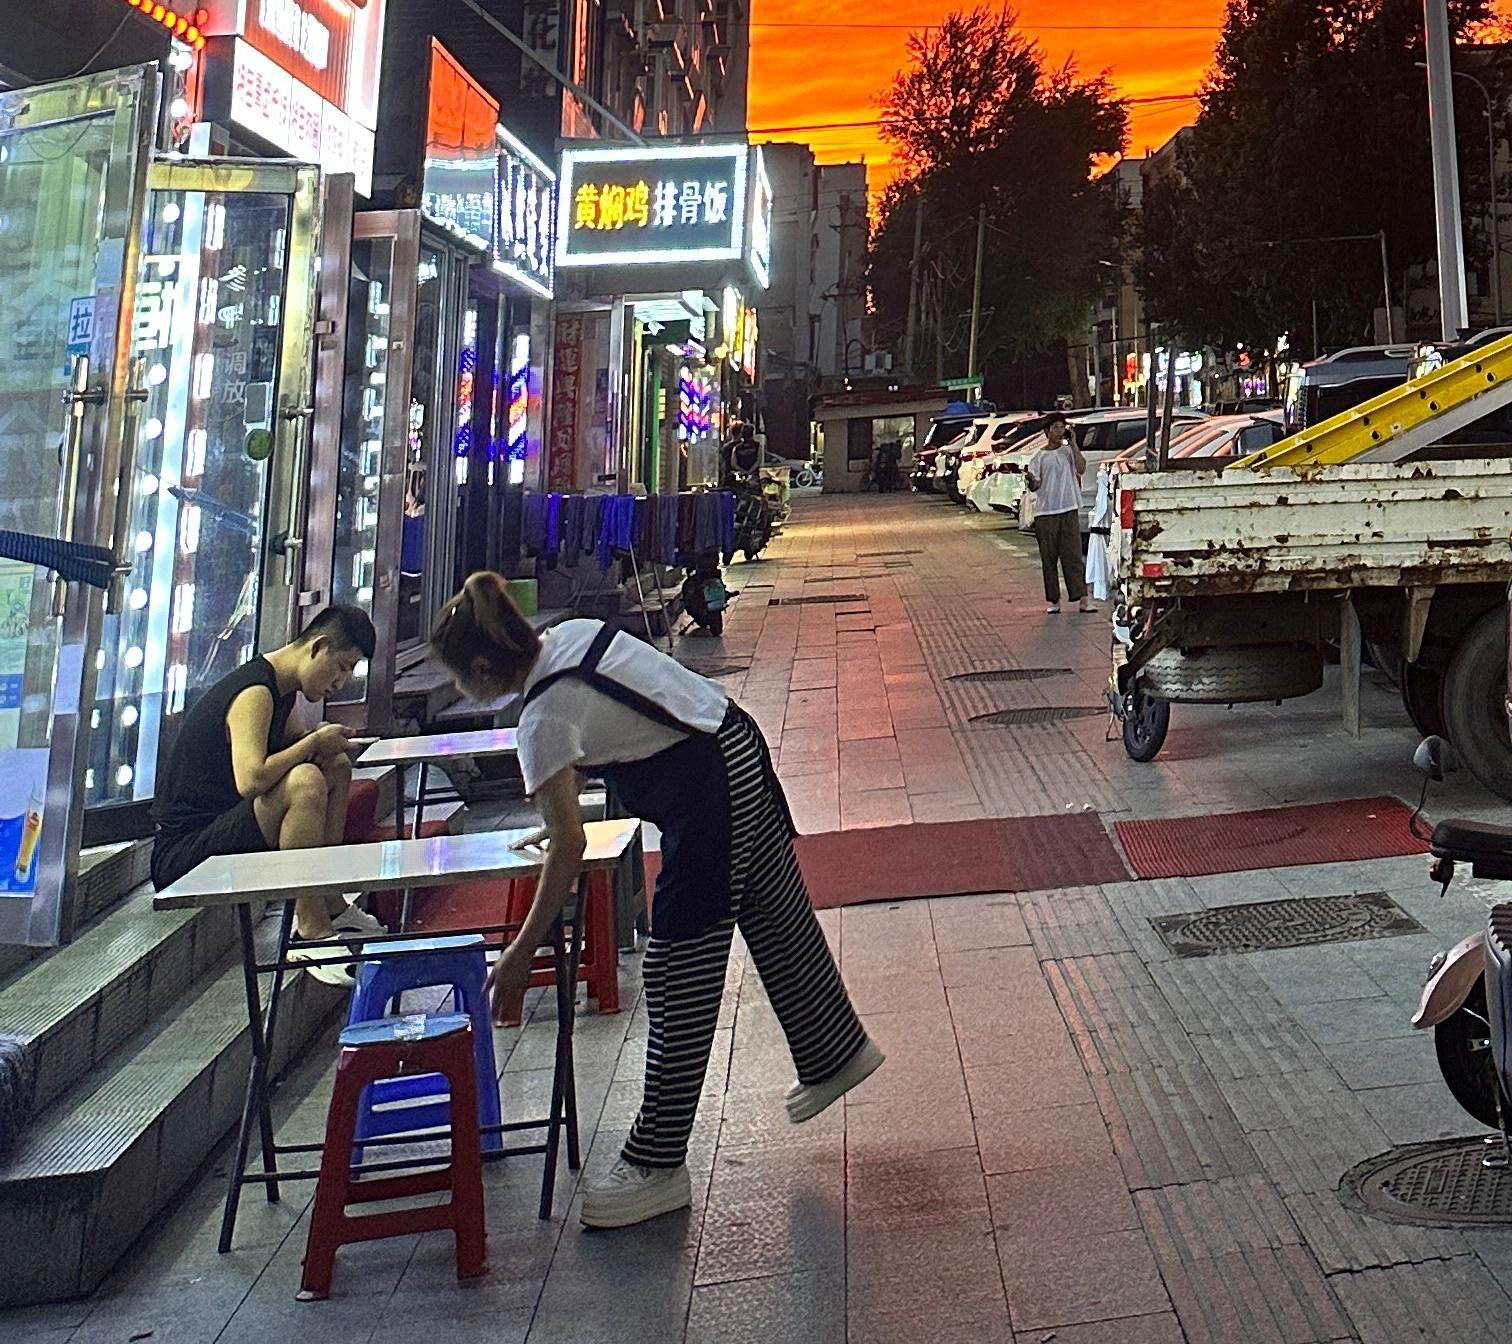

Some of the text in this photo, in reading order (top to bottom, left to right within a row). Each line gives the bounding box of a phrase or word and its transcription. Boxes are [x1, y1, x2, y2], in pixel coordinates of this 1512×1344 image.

[574, 179, 728, 230] 黄焖鸡 排骨饭
[71, 306, 93, 343] 拉
